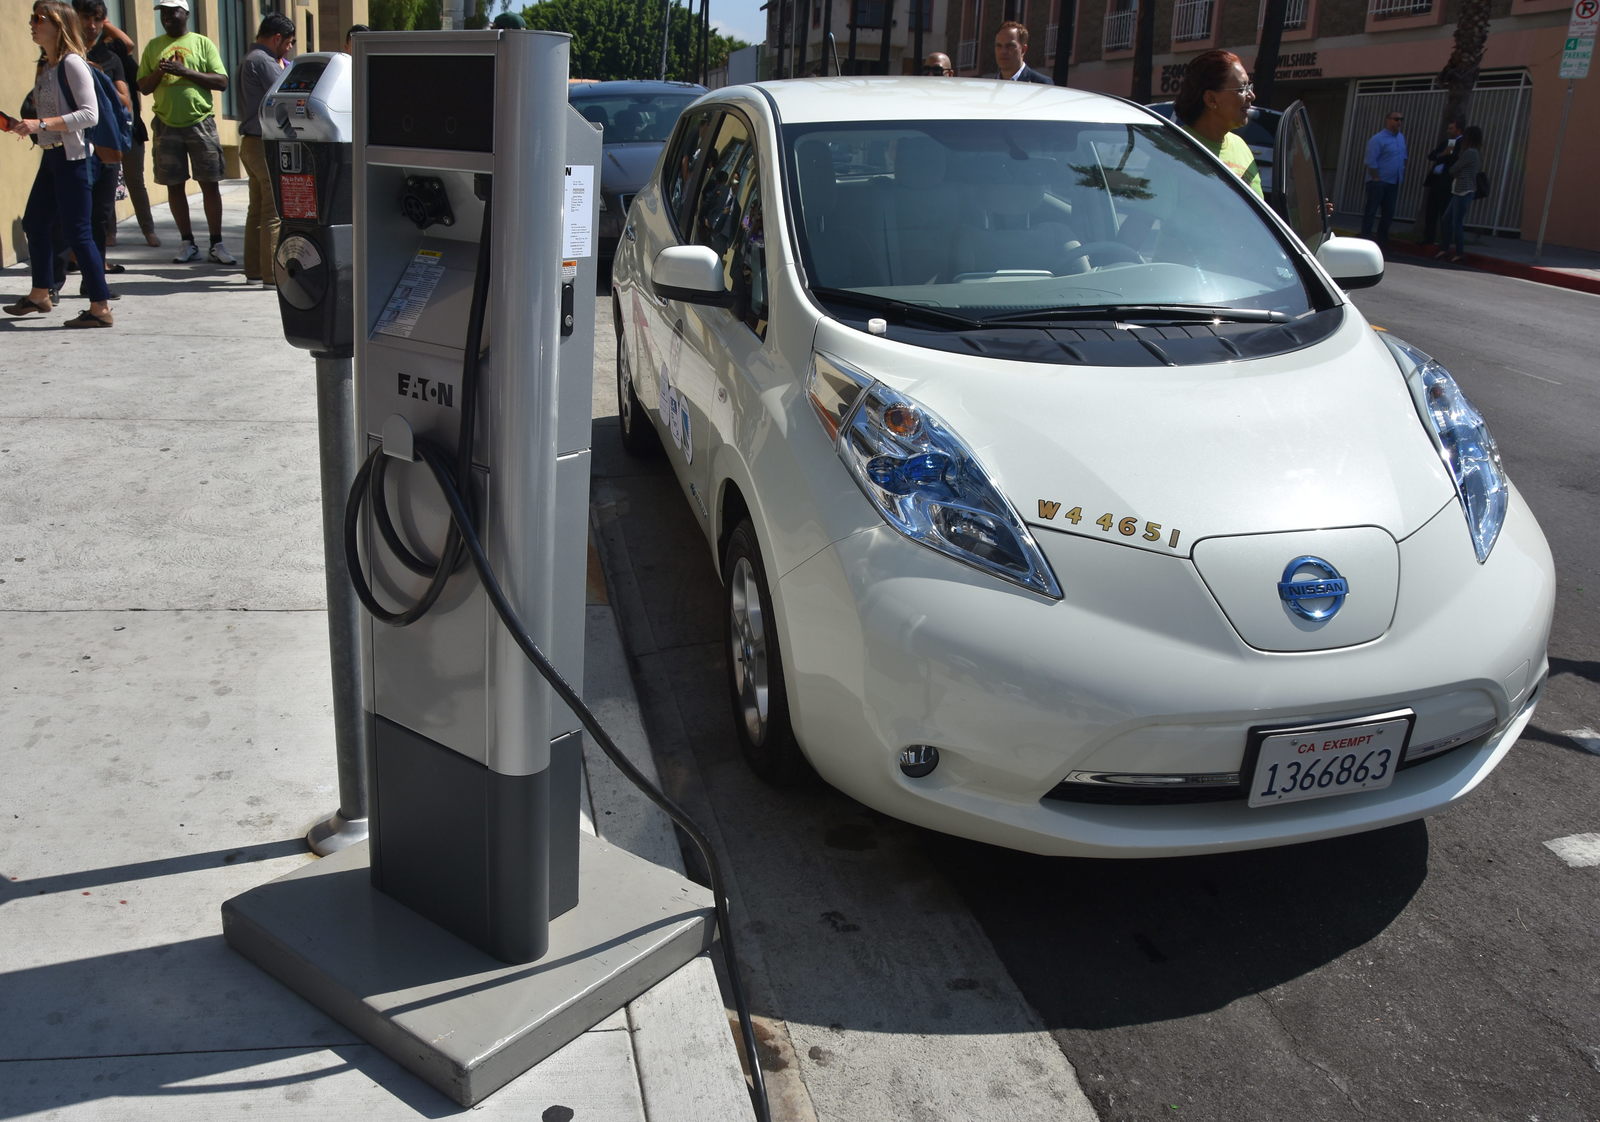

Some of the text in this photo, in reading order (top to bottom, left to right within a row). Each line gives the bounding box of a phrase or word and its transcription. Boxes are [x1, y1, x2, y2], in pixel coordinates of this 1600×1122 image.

[1567, 40, 1575, 49] 4
[1564, 51, 1590, 59] PARKING
[1292, 68, 1323, 78] HOSPITAL
[398, 373, 453, 408] EATON
[1289, 581, 1344, 597] NISSAN
[1297, 734, 1374, 754] CA EXEMPT
[1260, 749, 1392, 797] 1366863
